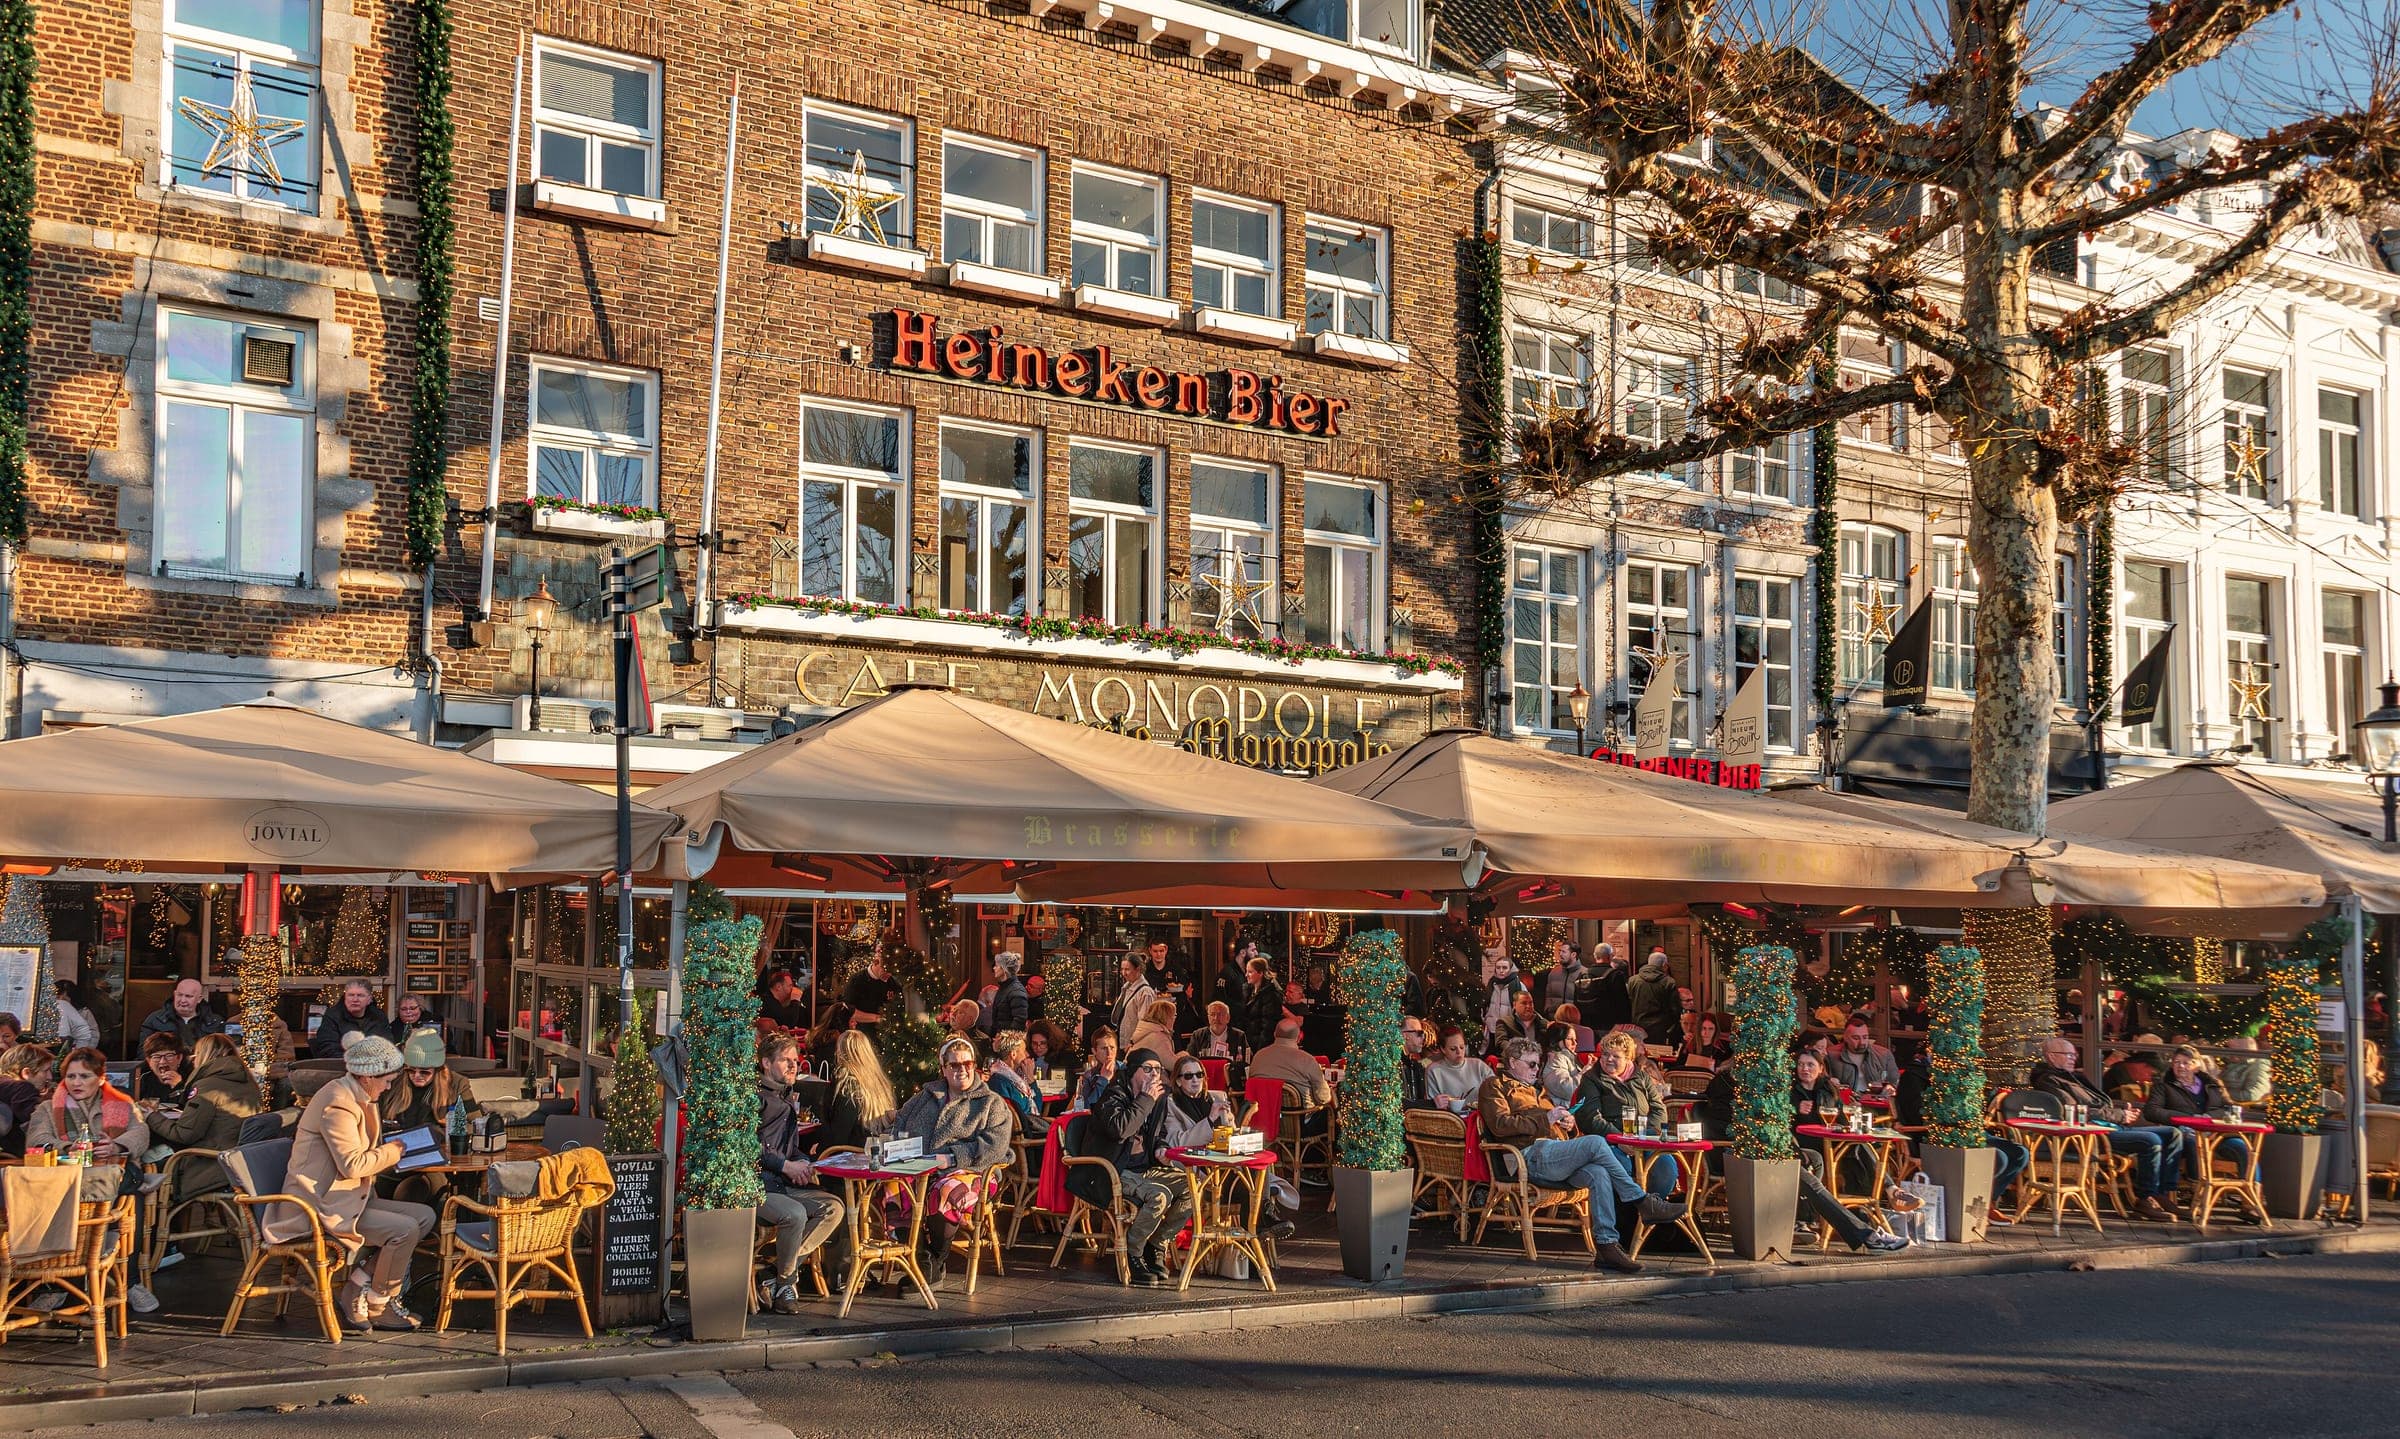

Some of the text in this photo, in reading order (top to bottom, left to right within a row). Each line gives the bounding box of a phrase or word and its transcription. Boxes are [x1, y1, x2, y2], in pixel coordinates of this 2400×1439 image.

[892, 307, 1351, 436] Heineken Bier
[1718, 760, 1761, 790] BIER
[250, 825, 322, 842] JOVIAL
[1024, 814, 1242, 849] Brasserie
[614, 1161, 656, 1172] JOVIAL
[617, 1173, 649, 1182] DINER
[616, 1182, 648, 1191] VLEES
[624, 1190, 641, 1198] VIS
[613, 1195, 653, 1206] PASTA'S
[620, 1205, 647, 1214] VEGA
[609, 1212, 655, 1223] SALADES
[613, 1234, 651, 1244] BIEREN
[610, 1243, 649, 1253] WIJNEN
[606, 1251, 658, 1262] COCKTAILS
[612, 1267, 652, 1277] BORREL
[611, 1277, 650, 1287] HAPJES
